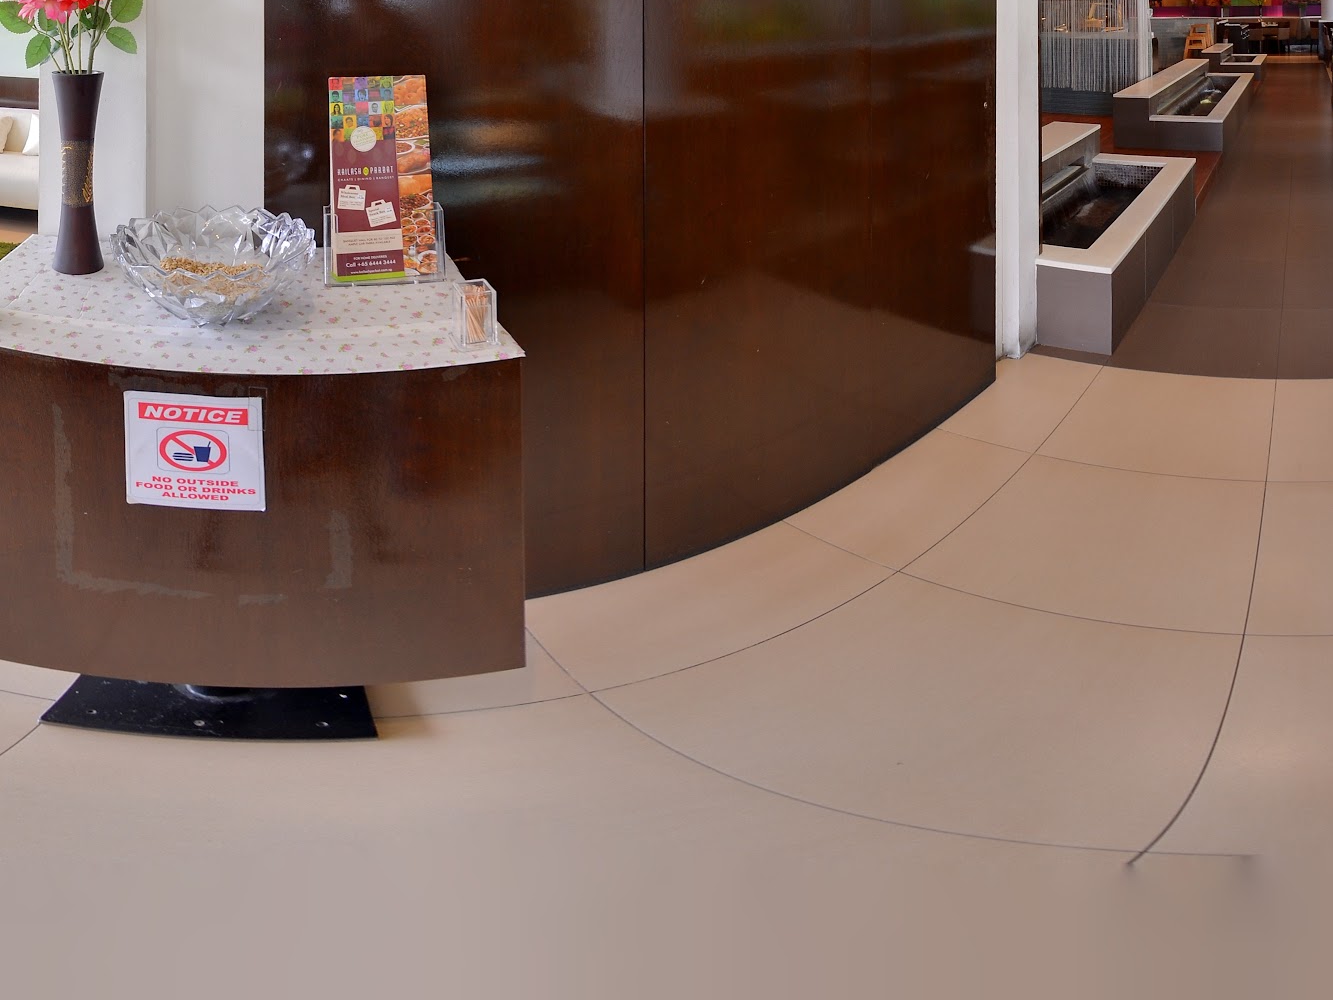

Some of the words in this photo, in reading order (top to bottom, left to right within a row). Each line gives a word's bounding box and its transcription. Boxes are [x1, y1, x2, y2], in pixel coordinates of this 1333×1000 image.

[144, 405, 243, 423] NOTICE
[136, 481, 173, 490] FOOD
[202, 487, 256, 495] DRINKS
[176, 478, 239, 487] OUTSIDE
[162, 491, 229, 501] ALLOWED
